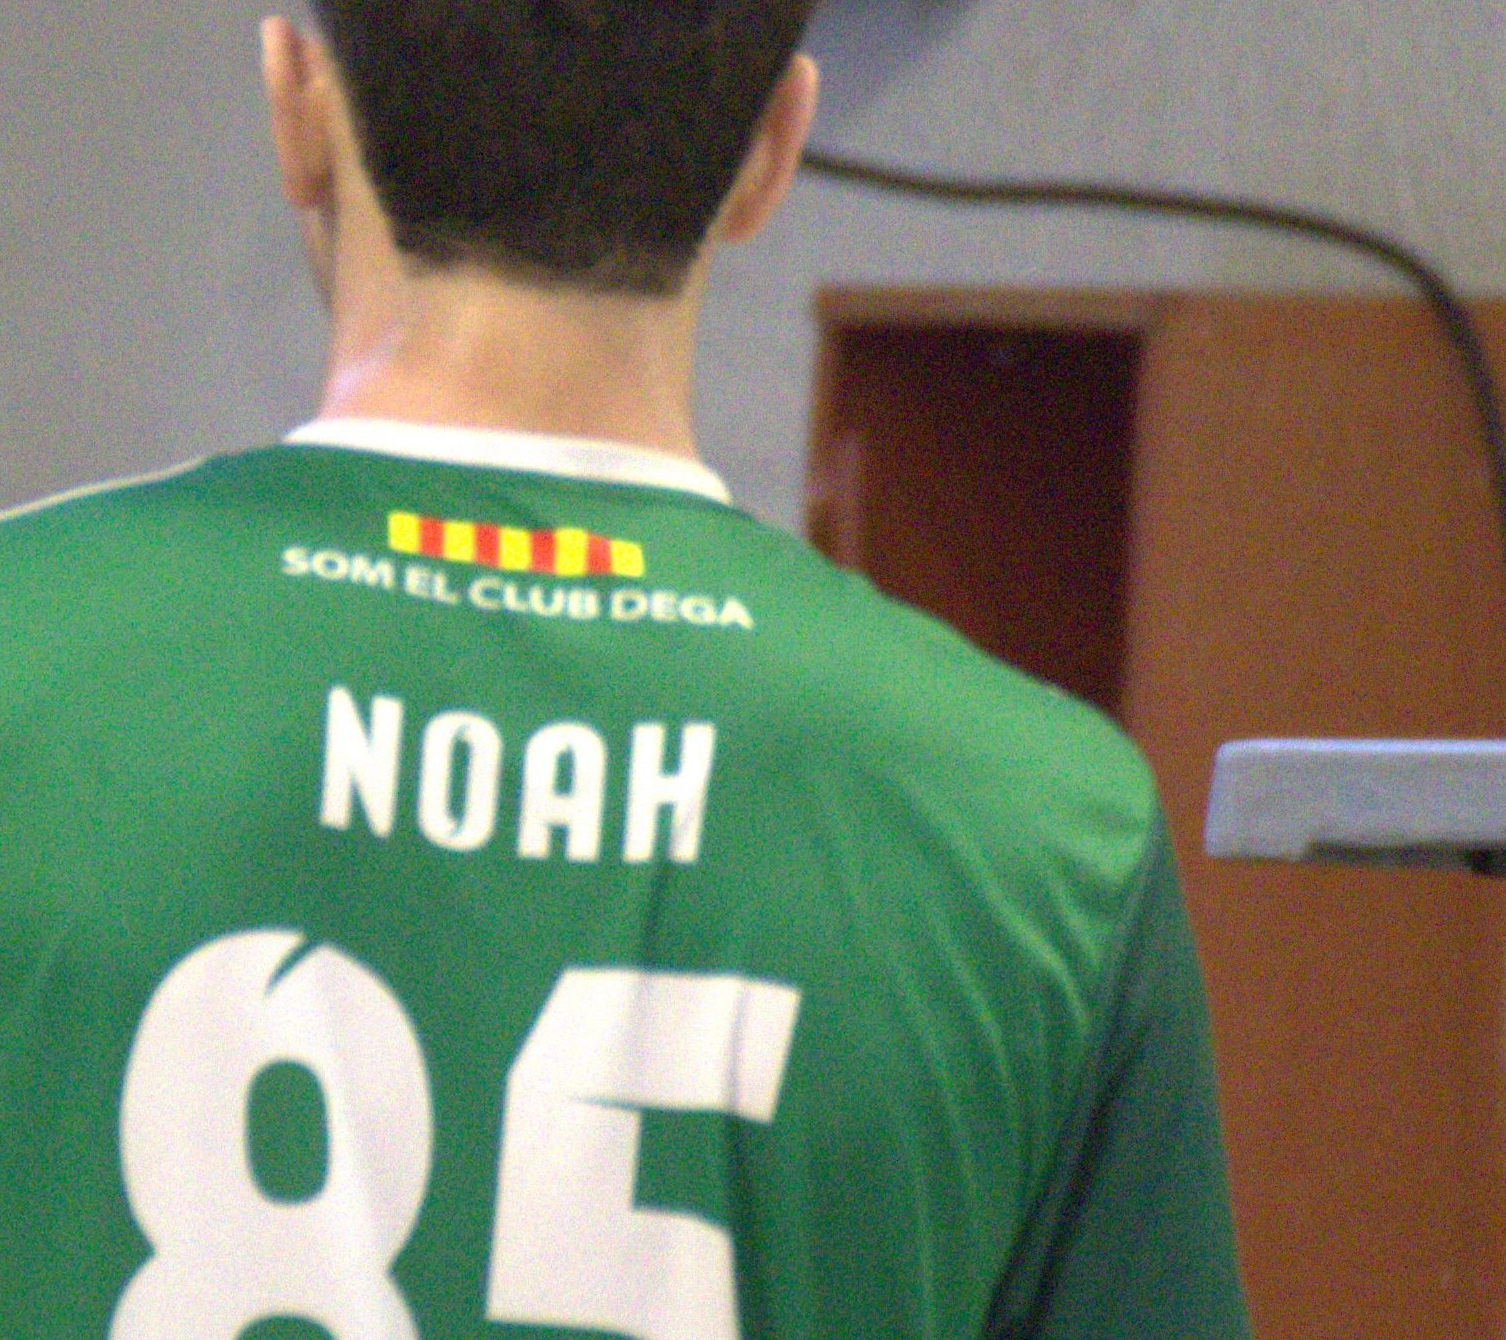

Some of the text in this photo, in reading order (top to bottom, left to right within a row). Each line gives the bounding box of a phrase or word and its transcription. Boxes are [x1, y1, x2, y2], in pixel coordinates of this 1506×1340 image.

[281, 545, 395, 589] SOM
[404, 564, 461, 606] EL
[467, 576, 600, 621] CLUB
[320, 684, 716, 863] NOAH
